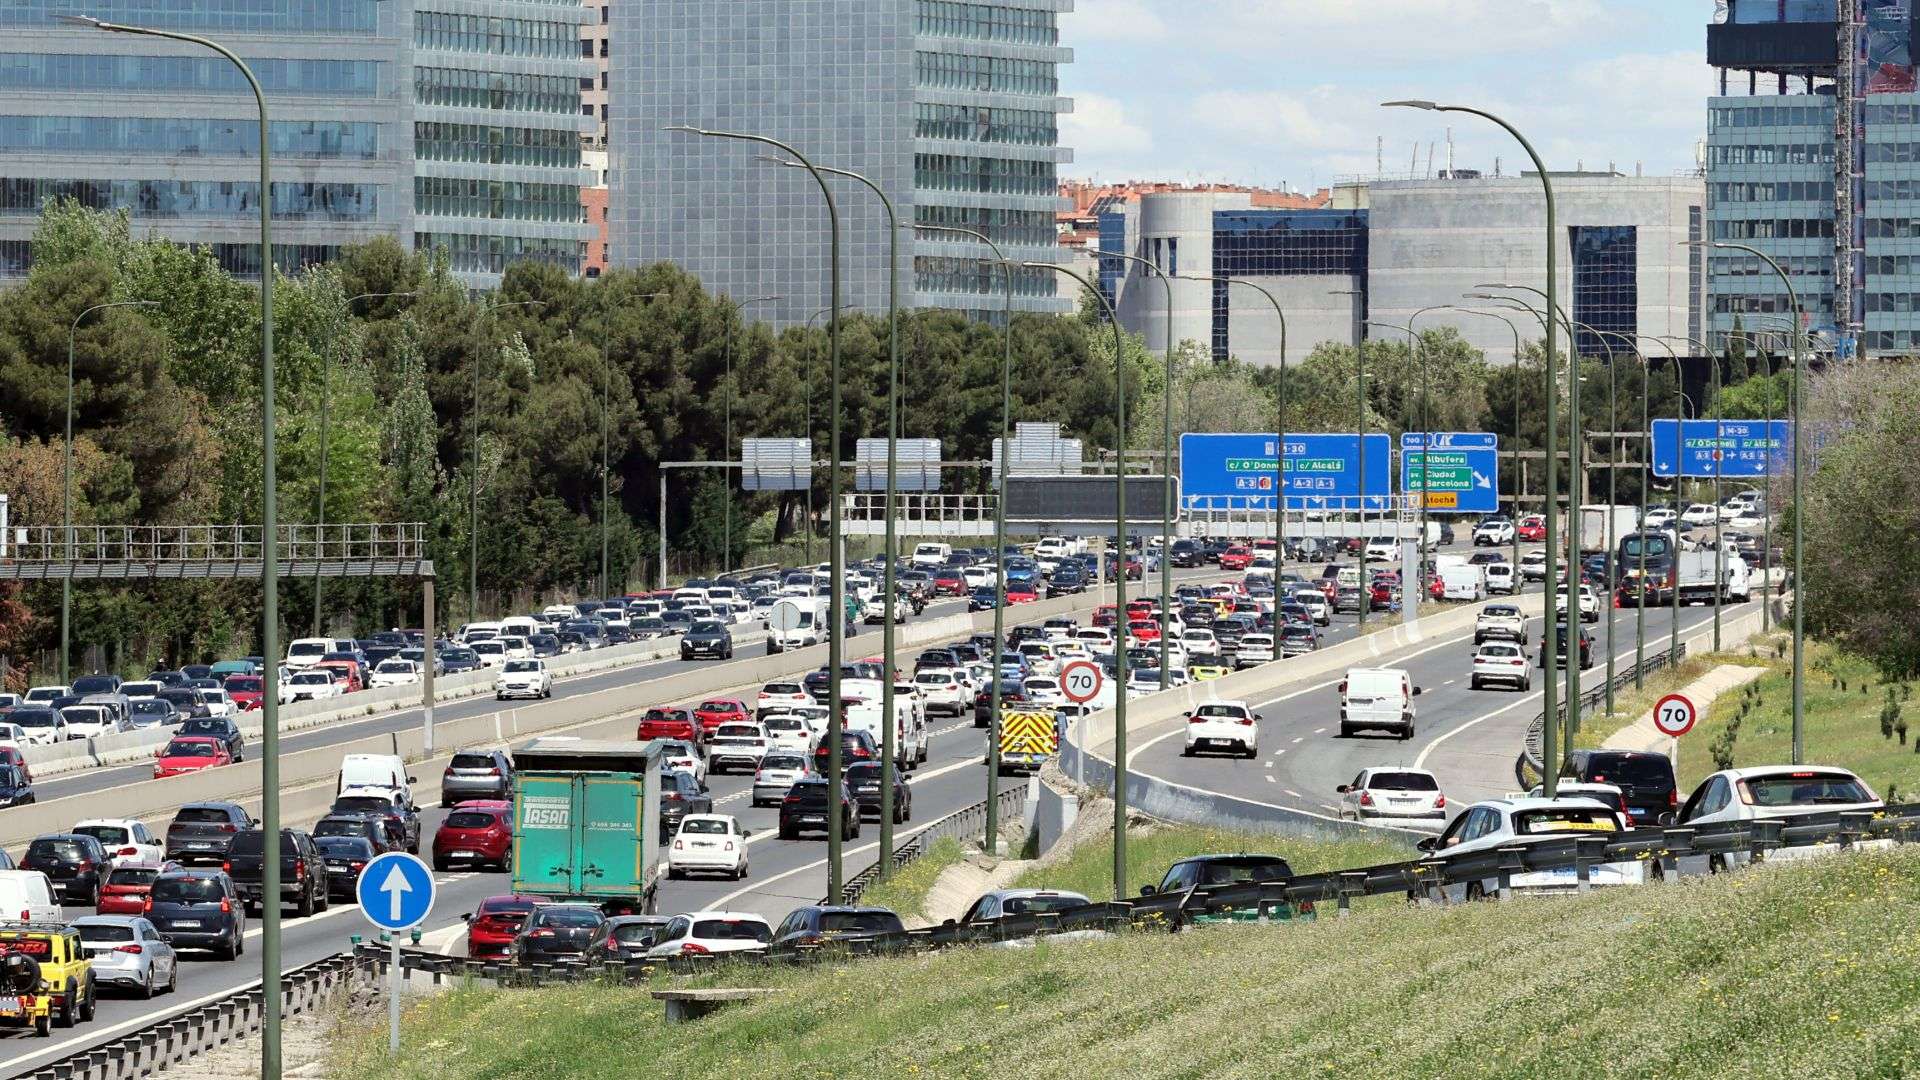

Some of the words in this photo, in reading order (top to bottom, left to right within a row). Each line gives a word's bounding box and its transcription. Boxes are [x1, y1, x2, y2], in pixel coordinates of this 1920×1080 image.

[1312, 461, 1342, 469] Alcalá
[1070, 676, 1092, 688] 70
[1663, 708, 1686, 722] 70
[524, 804, 570, 824] TASAN
